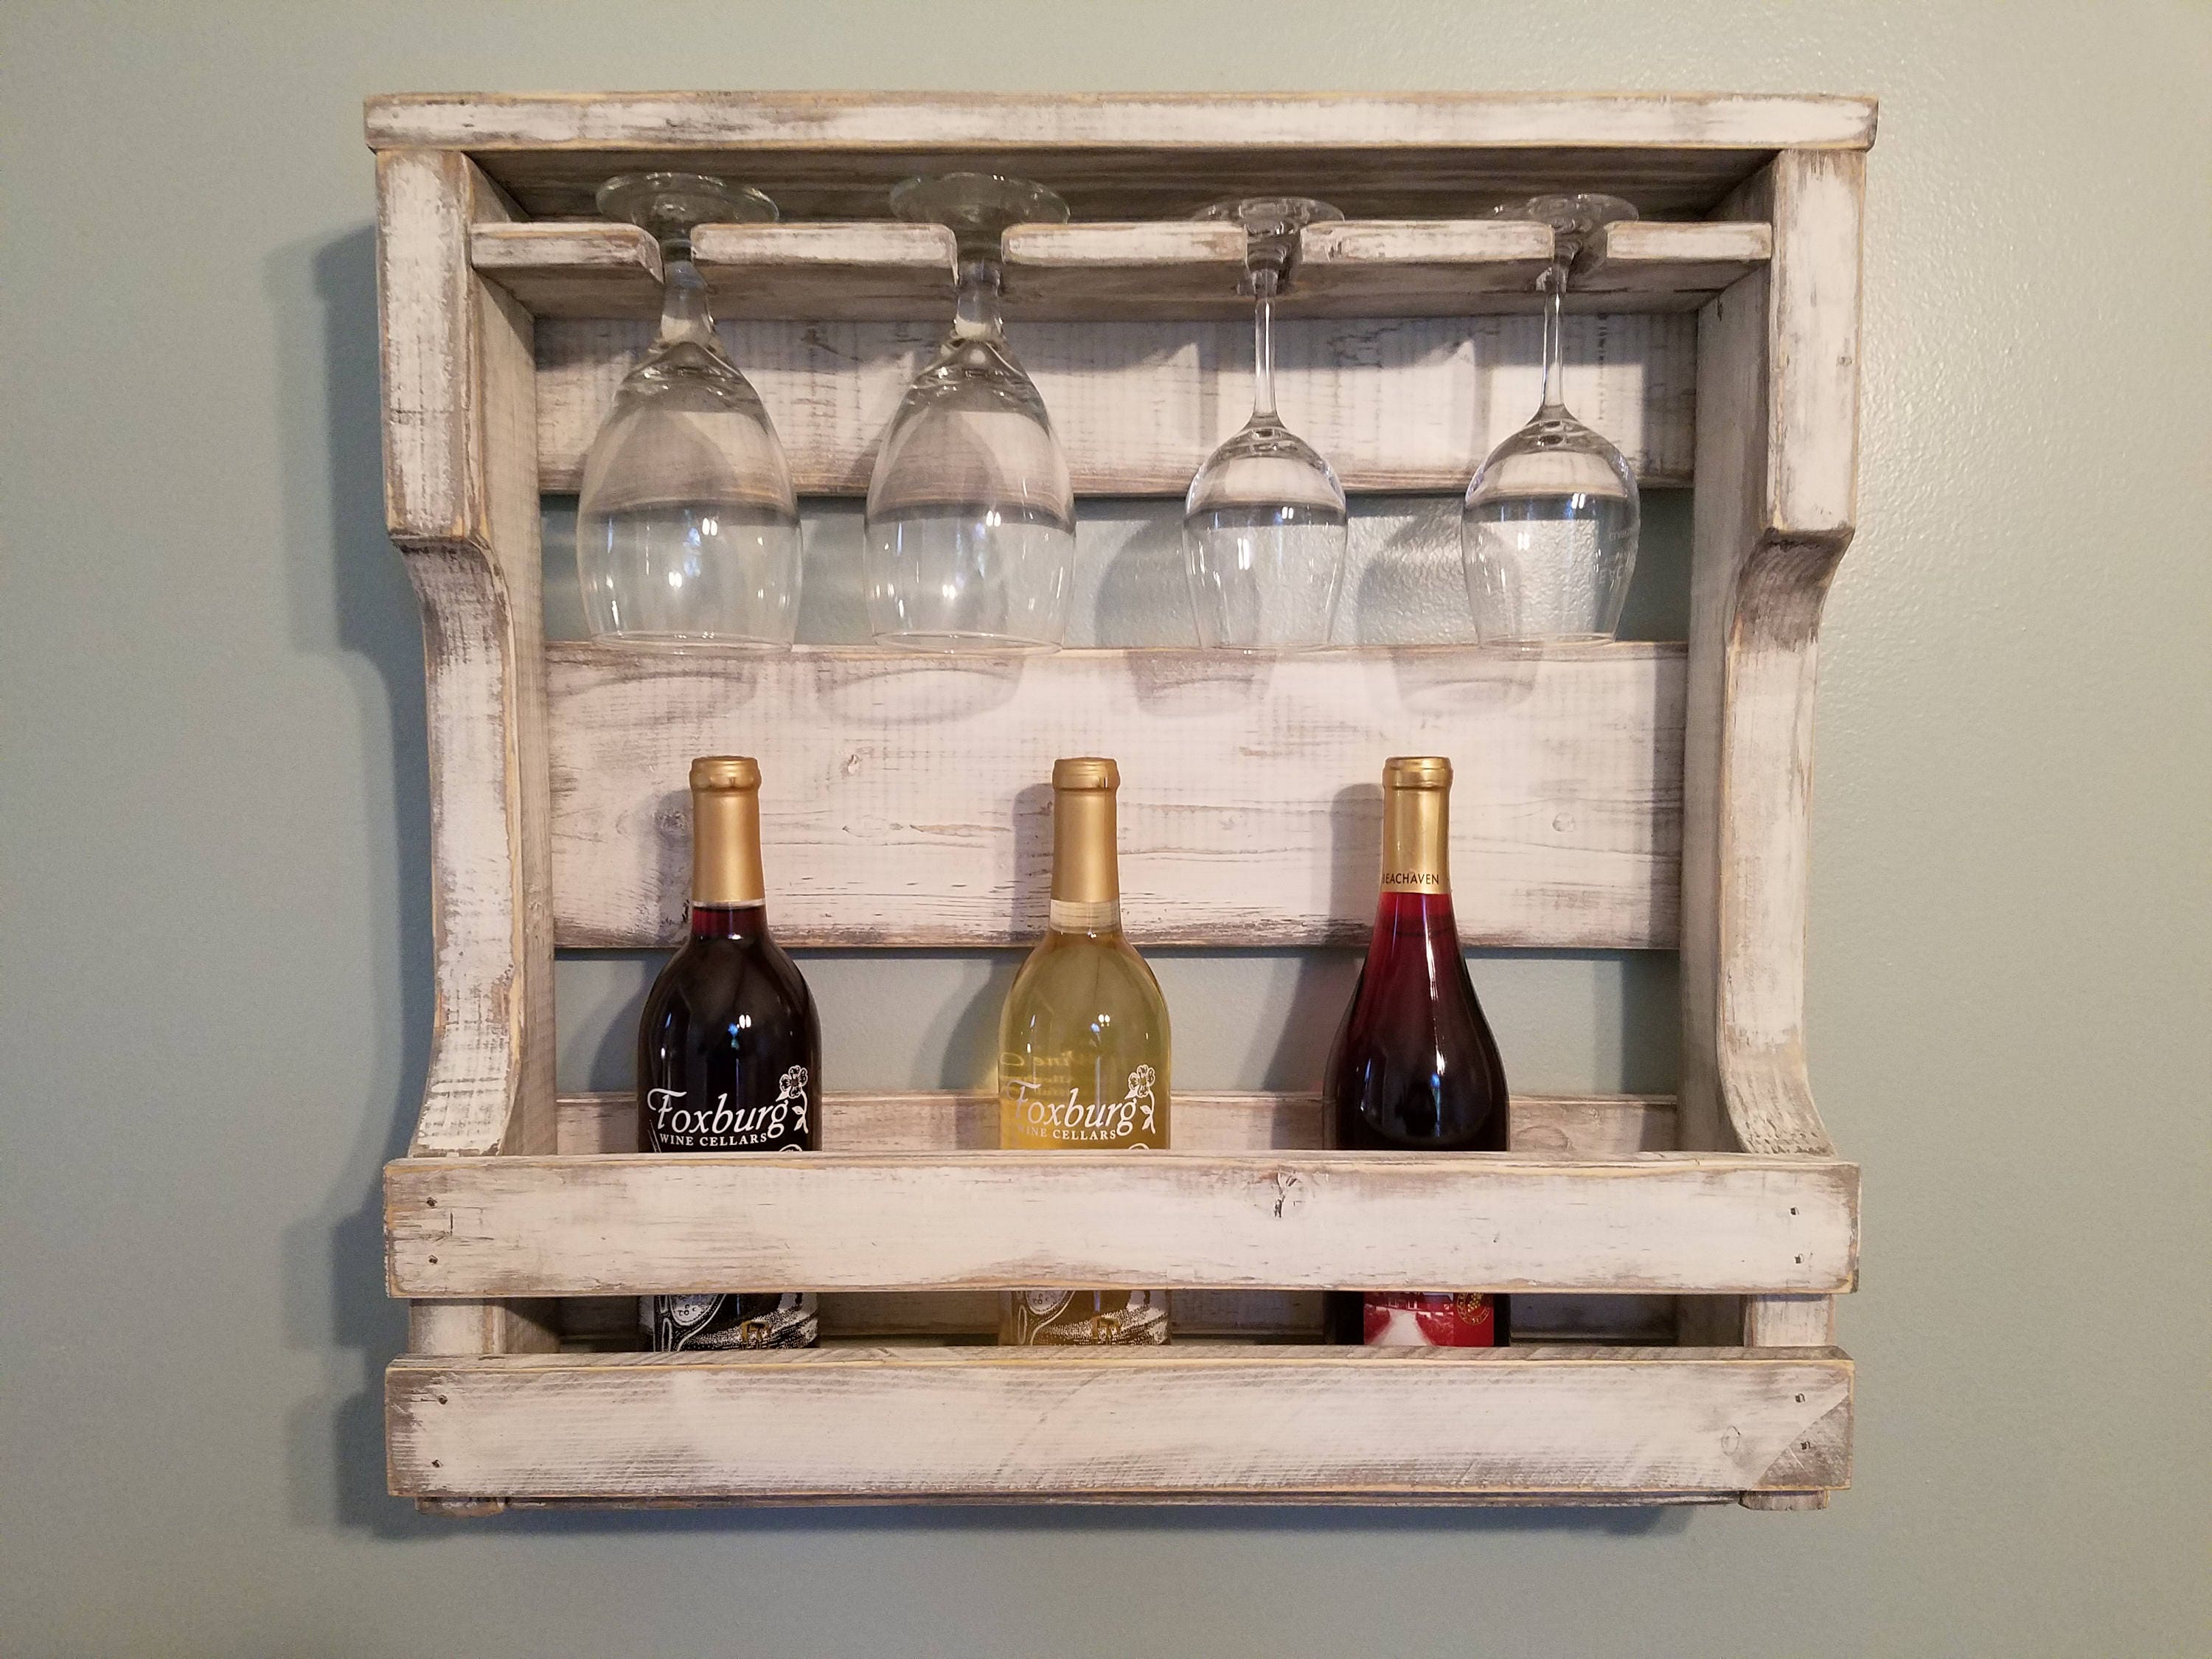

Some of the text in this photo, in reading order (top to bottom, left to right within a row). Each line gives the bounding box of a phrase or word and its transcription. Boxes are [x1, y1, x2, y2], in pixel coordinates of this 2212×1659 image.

[647, 1088, 788, 1138] Foxburg
[1005, 1079, 1137, 1136] Foxburg
[659, 1133, 768, 1147] WINE CELLARS
[1052, 1129, 1118, 1141] CELLARS
